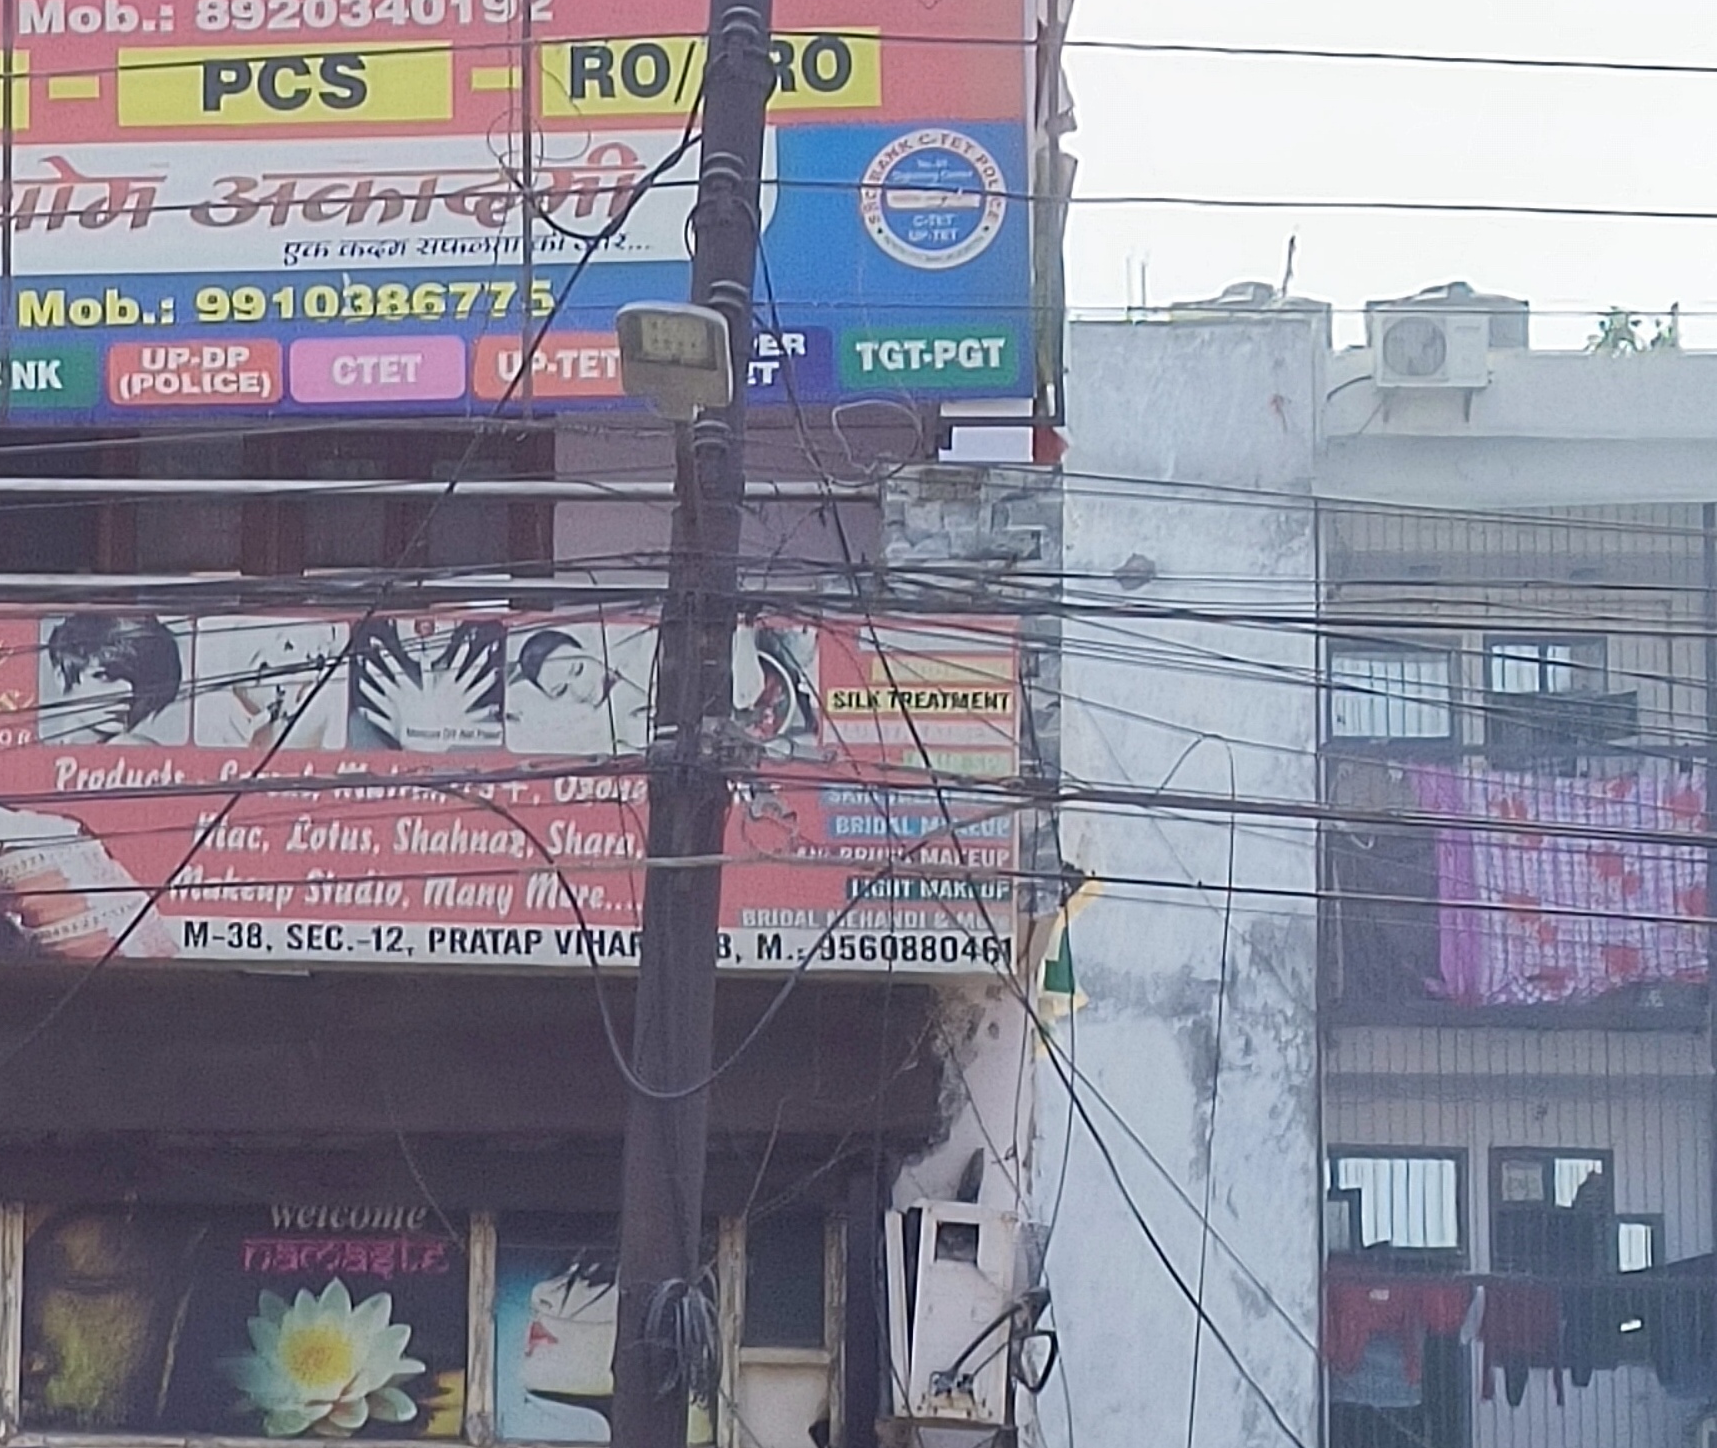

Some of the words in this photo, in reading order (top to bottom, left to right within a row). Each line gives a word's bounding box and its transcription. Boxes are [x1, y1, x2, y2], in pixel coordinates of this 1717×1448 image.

[201, 52, 368, 112] PCS
[18, 289, 175, 328] Mob.:
[195, 281, 554, 325] 9910386775
[142, 346, 251, 371] UP-DP
[331, 355, 423, 386] CTET
[497, 351, 621, 383] UP-TET
[856, 337, 1007, 372] TGT-PGT
[119, 369, 272, 400] (POLICE)
[833, 690, 881, 709] SILK
[888, 690, 1011, 711] TREATMENT
[286, 814, 381, 856] Lotus,
[835, 815, 917, 836] BRIDAL
[170, 864, 294, 911] Makeup
[304, 867, 410, 909] Studio,
[423, 873, 514, 918] Many
[742, 907, 820, 927] BRIDAL
[183, 921, 273, 953] M-38,
[286, 924, 416, 957] SEC.-12,
[428, 927, 543, 956] PRATAP
[269, 1202, 429, 1232] welcome
